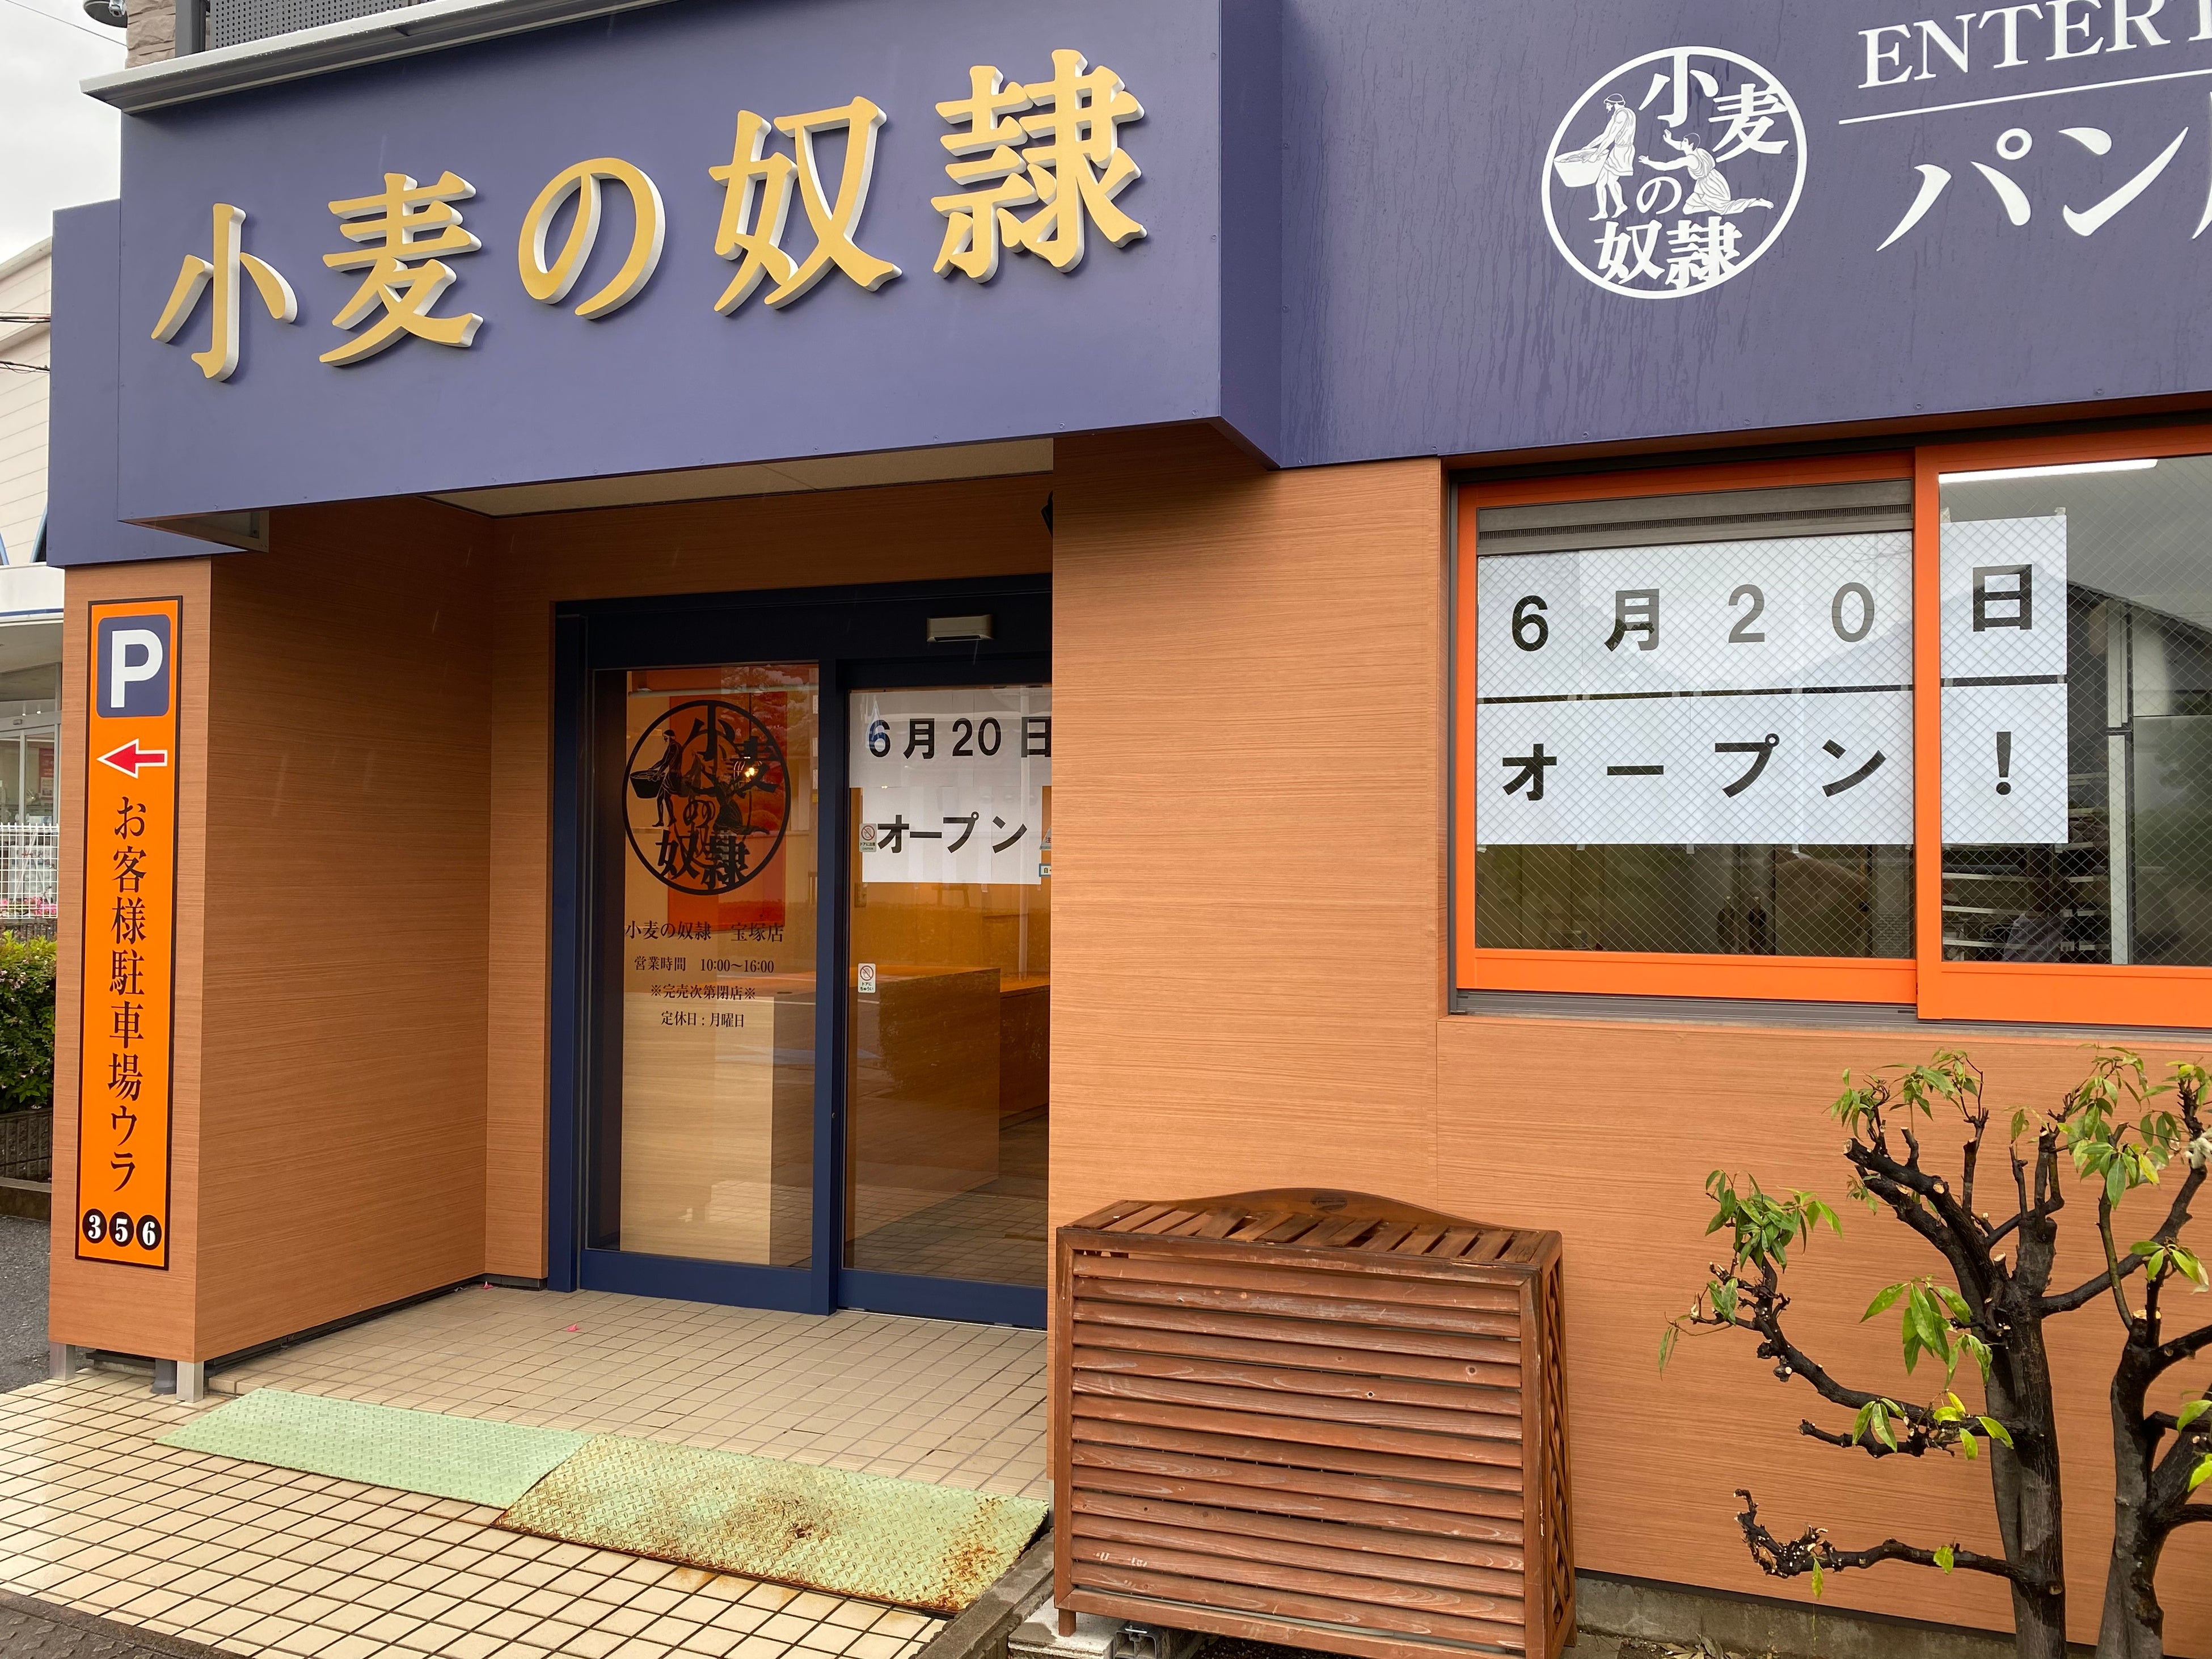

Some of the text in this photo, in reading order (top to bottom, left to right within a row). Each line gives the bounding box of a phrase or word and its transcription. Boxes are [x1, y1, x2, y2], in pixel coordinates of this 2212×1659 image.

[1875, 91, 2212, 252] パン
[151, 48, 1149, 383] 小麦の奴隷
[109, 629, 163, 708] P
[877, 811, 1028, 854] オープン
[625, 920, 784, 943] 小麦の奴隷 宝塚店
[107, 795, 148, 1193] お客様駐車場ウラ
[634, 956, 686, 972] 営業時間
[651, 984, 755, 1001] ※完売次第閉店※
